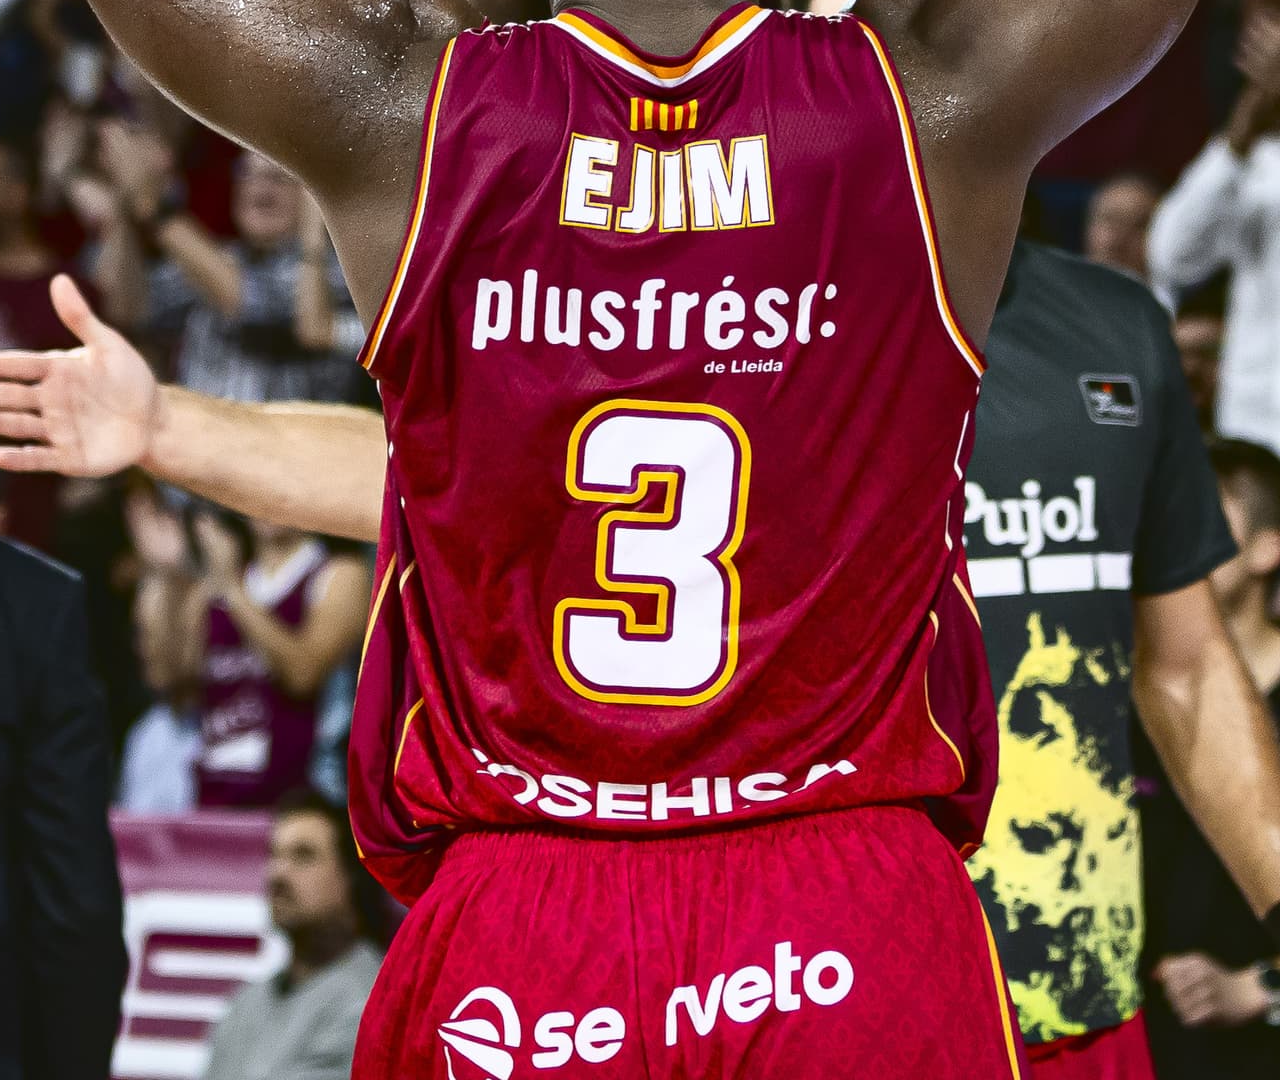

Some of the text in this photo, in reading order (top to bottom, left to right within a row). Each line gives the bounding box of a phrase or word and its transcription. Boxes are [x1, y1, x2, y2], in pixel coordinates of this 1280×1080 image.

[558, 131, 776, 234] EJIM
[703, 359, 783, 374] de Lleida
[552, 398, 752, 707] 3
